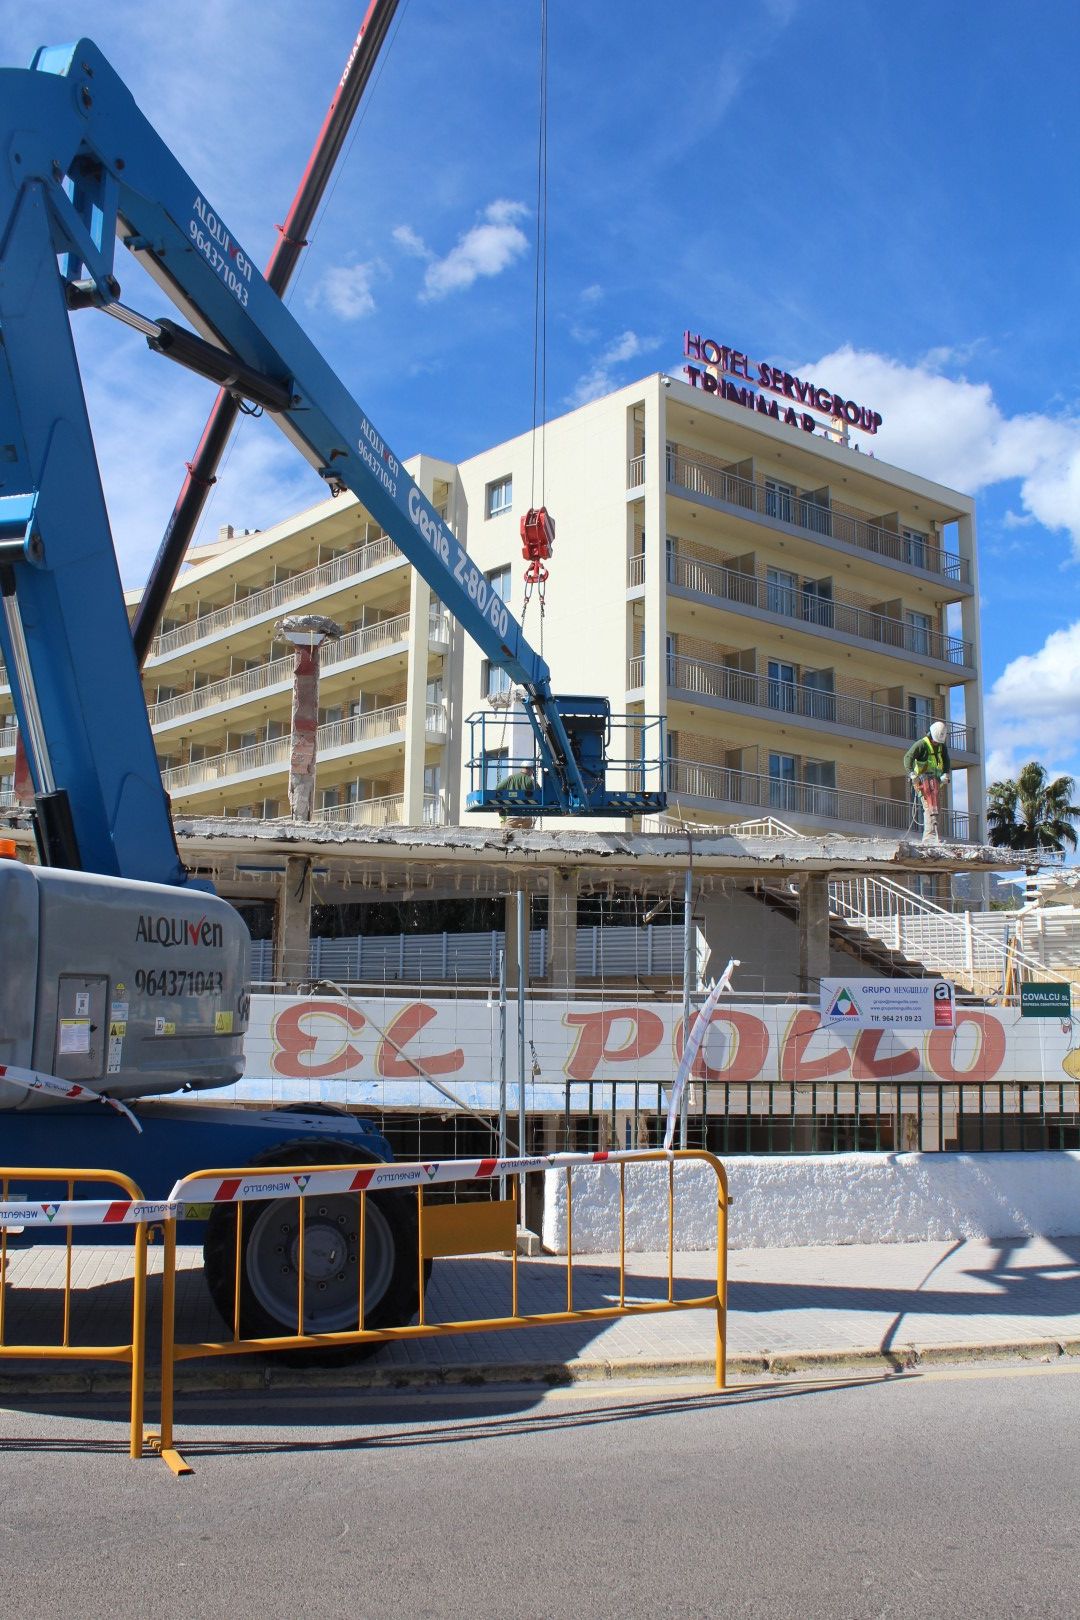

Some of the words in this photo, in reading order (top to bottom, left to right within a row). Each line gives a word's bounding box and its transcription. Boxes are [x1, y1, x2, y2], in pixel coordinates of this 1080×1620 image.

[189, 220, 249, 307] 964371043
[683, 330, 753, 381] HOTEL
[757, 362, 882, 434] SERVIGROUP
[358, 439, 397, 498] 964371043
[408, 487, 451, 566] Genie
[453, 549, 508, 638] Z-80/60
[135, 969, 223, 997] 964371043
[862, 986, 891, 994] GRUPO
[1022, 993, 1060, 1001] COVALCU
[271, 1001, 465, 1078] EL
[562, 1007, 1006, 1082] POLLO
[243, 1182, 291, 1195] MENGUILLÓ
